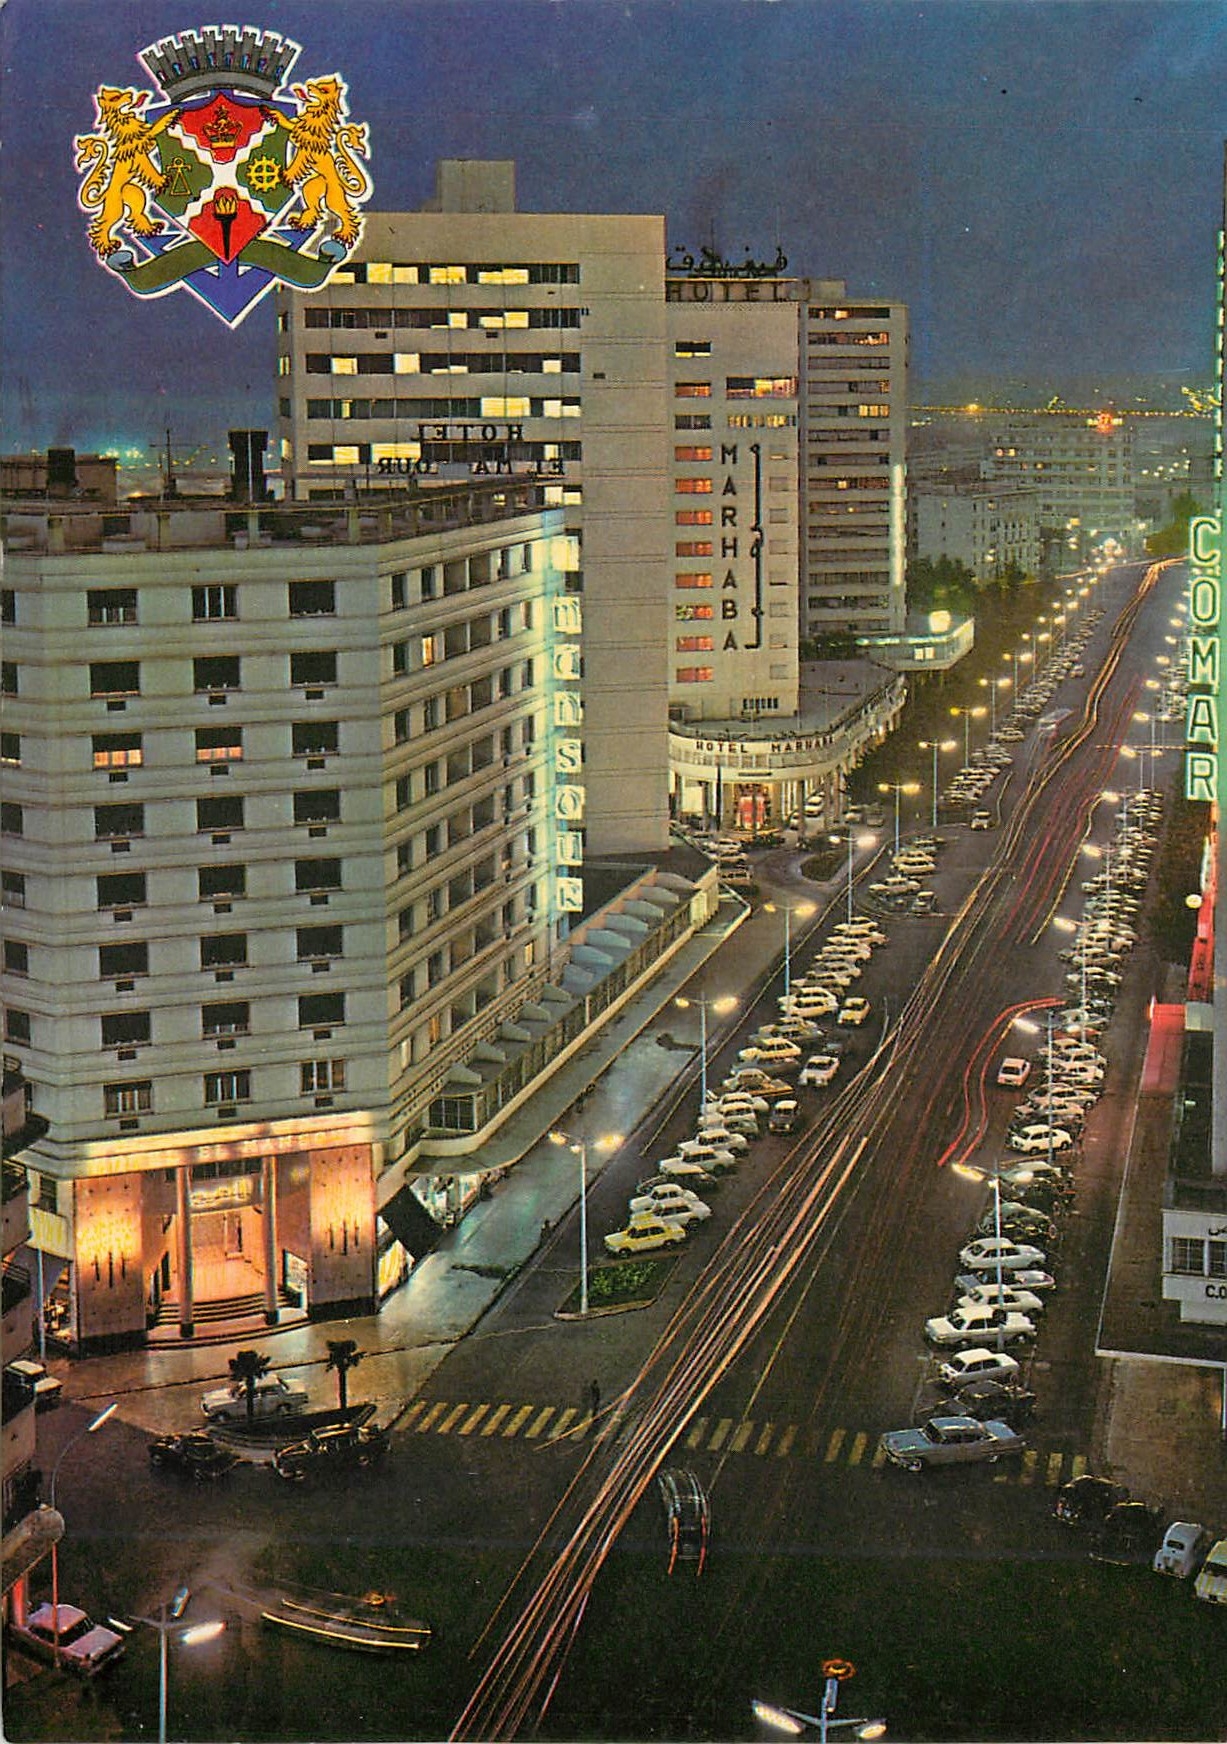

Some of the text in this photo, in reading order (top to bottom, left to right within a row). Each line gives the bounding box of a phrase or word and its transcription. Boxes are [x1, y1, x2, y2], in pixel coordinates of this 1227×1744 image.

[721, 444, 738, 650] MARHABA
[696, 741, 749, 754] HOTEL
[1187, 516, 1221, 801] COMAR
